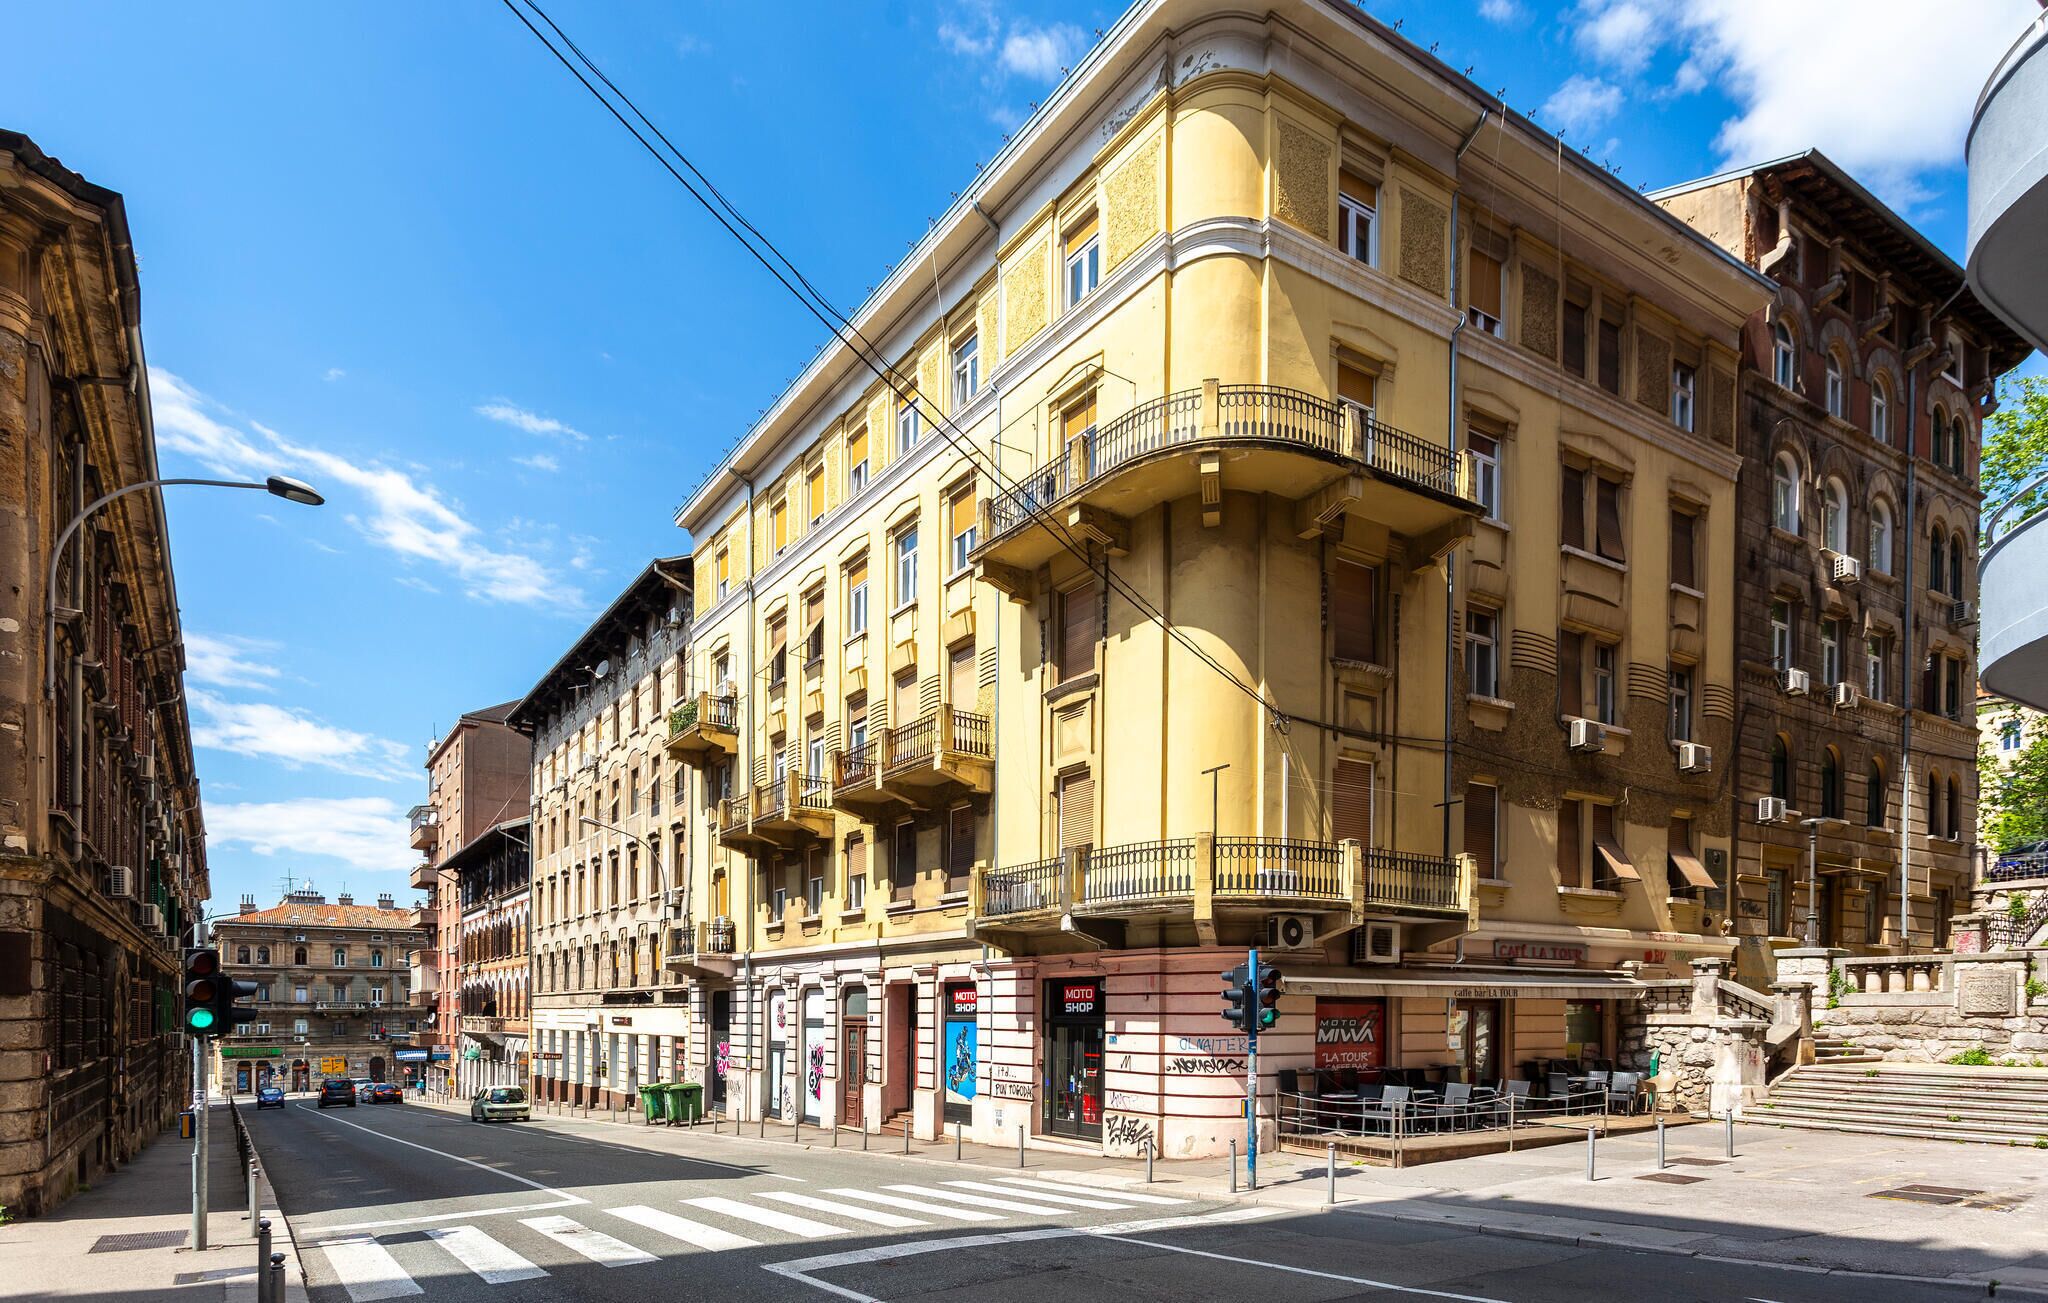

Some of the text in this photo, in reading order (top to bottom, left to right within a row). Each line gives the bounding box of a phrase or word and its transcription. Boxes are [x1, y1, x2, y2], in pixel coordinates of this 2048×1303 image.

[1500, 944, 1582, 961] CAFÉ LA TOUR
[955, 991, 976, 1001] MOTO
[1065, 989, 1093, 999] MOTO
[1474, 989, 1486, 998] bar
[1488, 989, 1497, 997] LA
[1500, 989, 1518, 998] TOUR
[955, 1003, 976, 1012] SHOP
[1065, 1002, 1094, 1013] SHOP
[1320, 1019, 1357, 1027] MOTO
